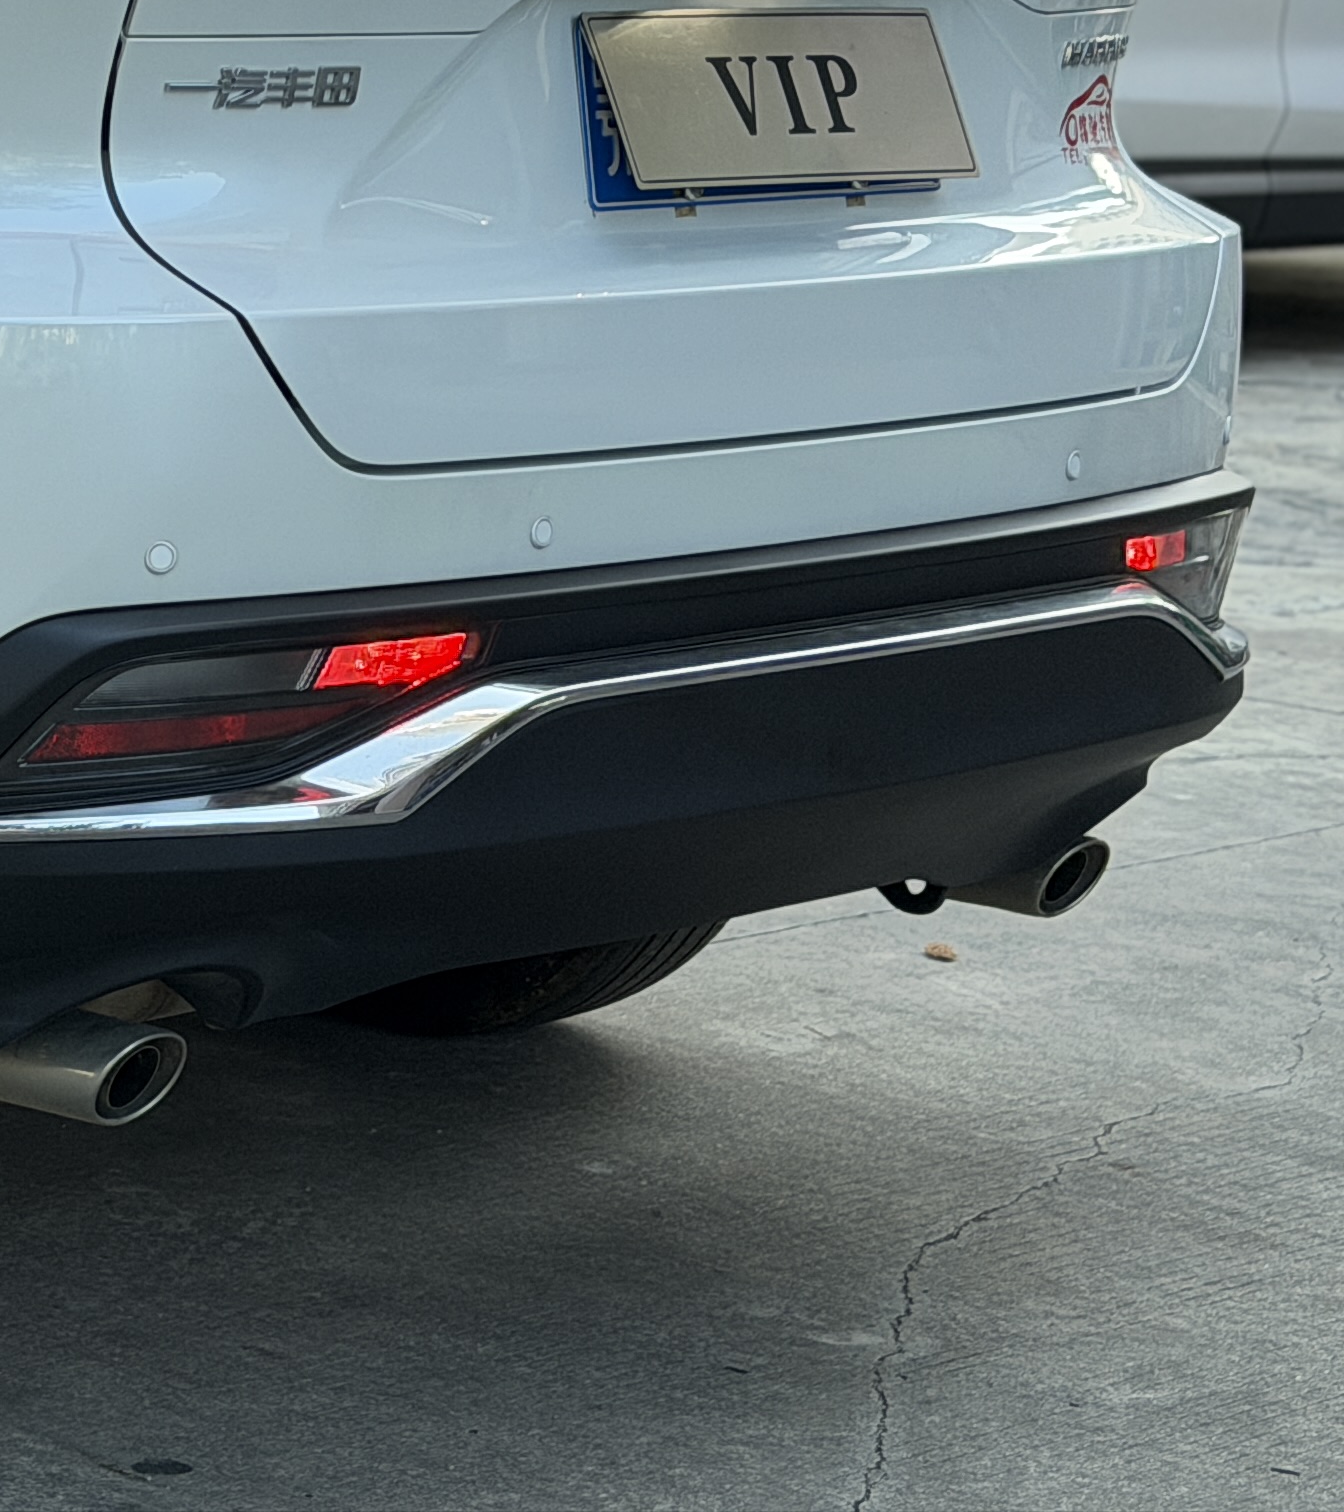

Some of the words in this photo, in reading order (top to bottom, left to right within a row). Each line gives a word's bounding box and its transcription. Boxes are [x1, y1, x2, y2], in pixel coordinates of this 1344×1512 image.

[164, 66, 362, 110] 一汽丰田
[705, 54, 858, 136] VIP
